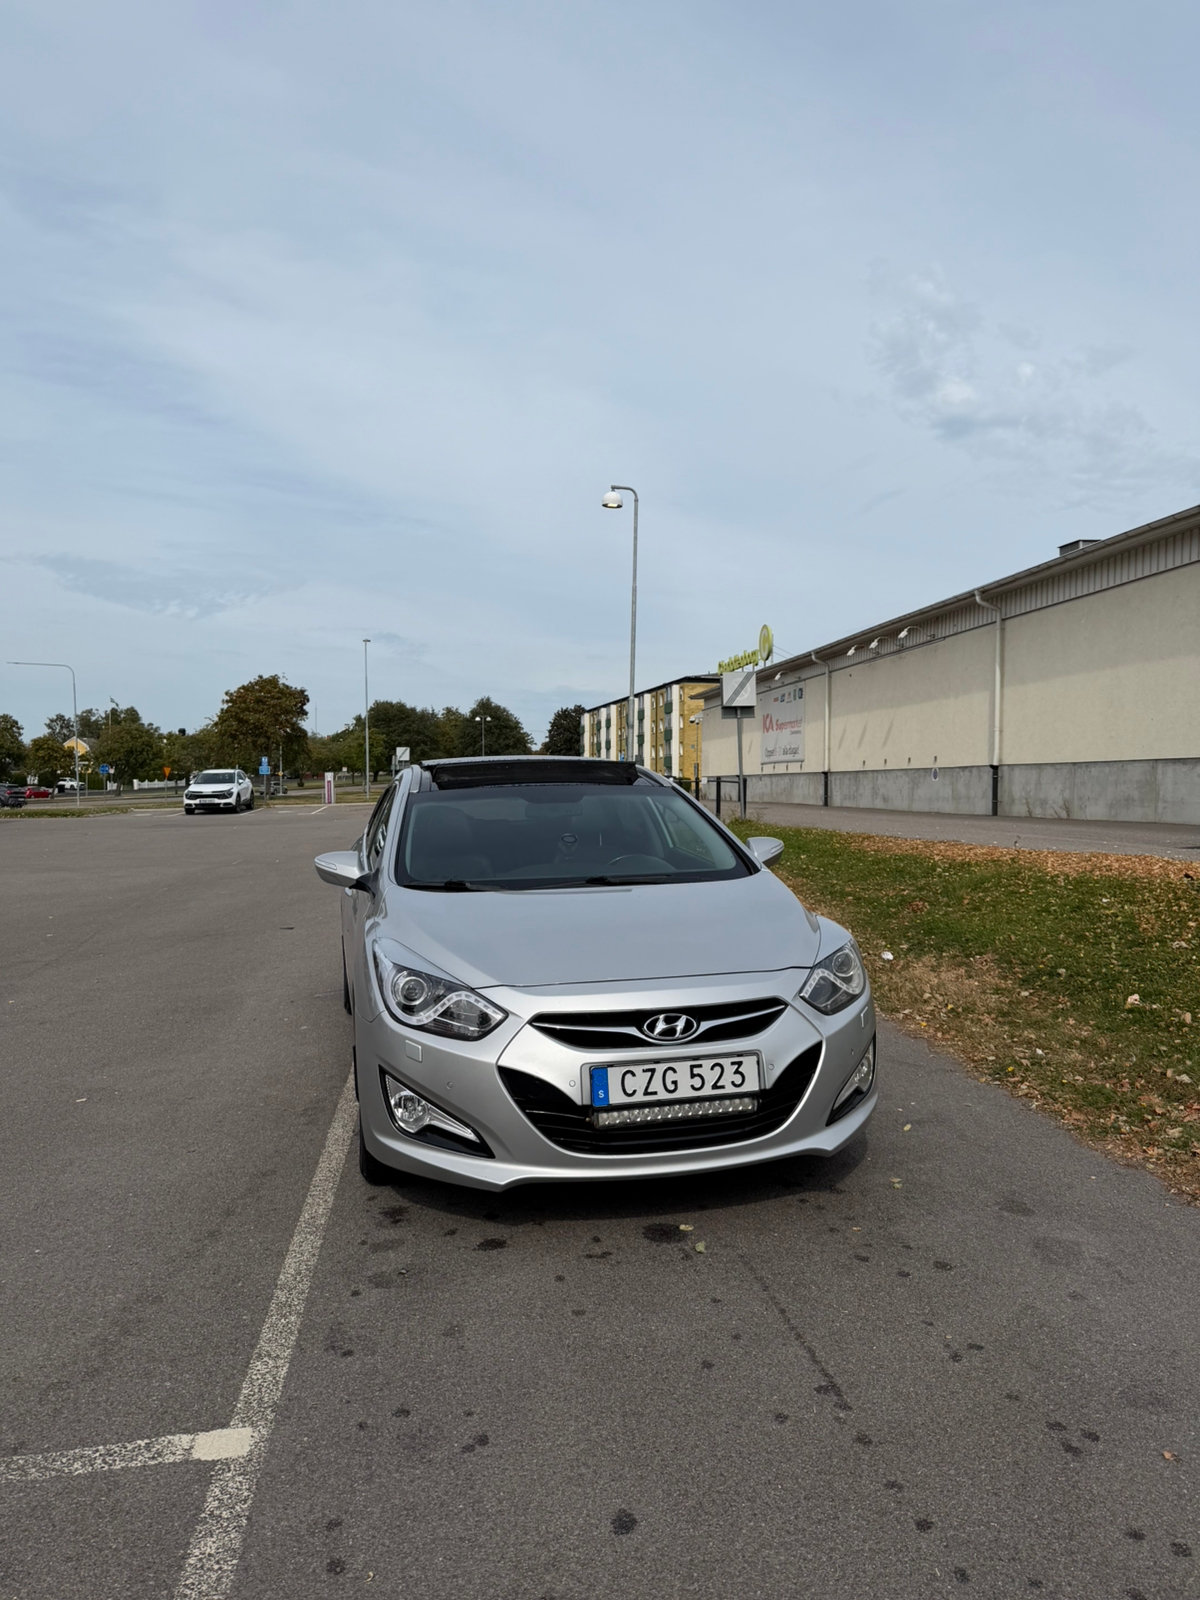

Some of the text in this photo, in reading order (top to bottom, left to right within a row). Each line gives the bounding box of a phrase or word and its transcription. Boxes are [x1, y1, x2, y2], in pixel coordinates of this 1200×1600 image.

[762, 713, 774, 733] ICA
[621, 1060, 746, 1098] CZG 523
[598, 1090, 605, 1098] S
